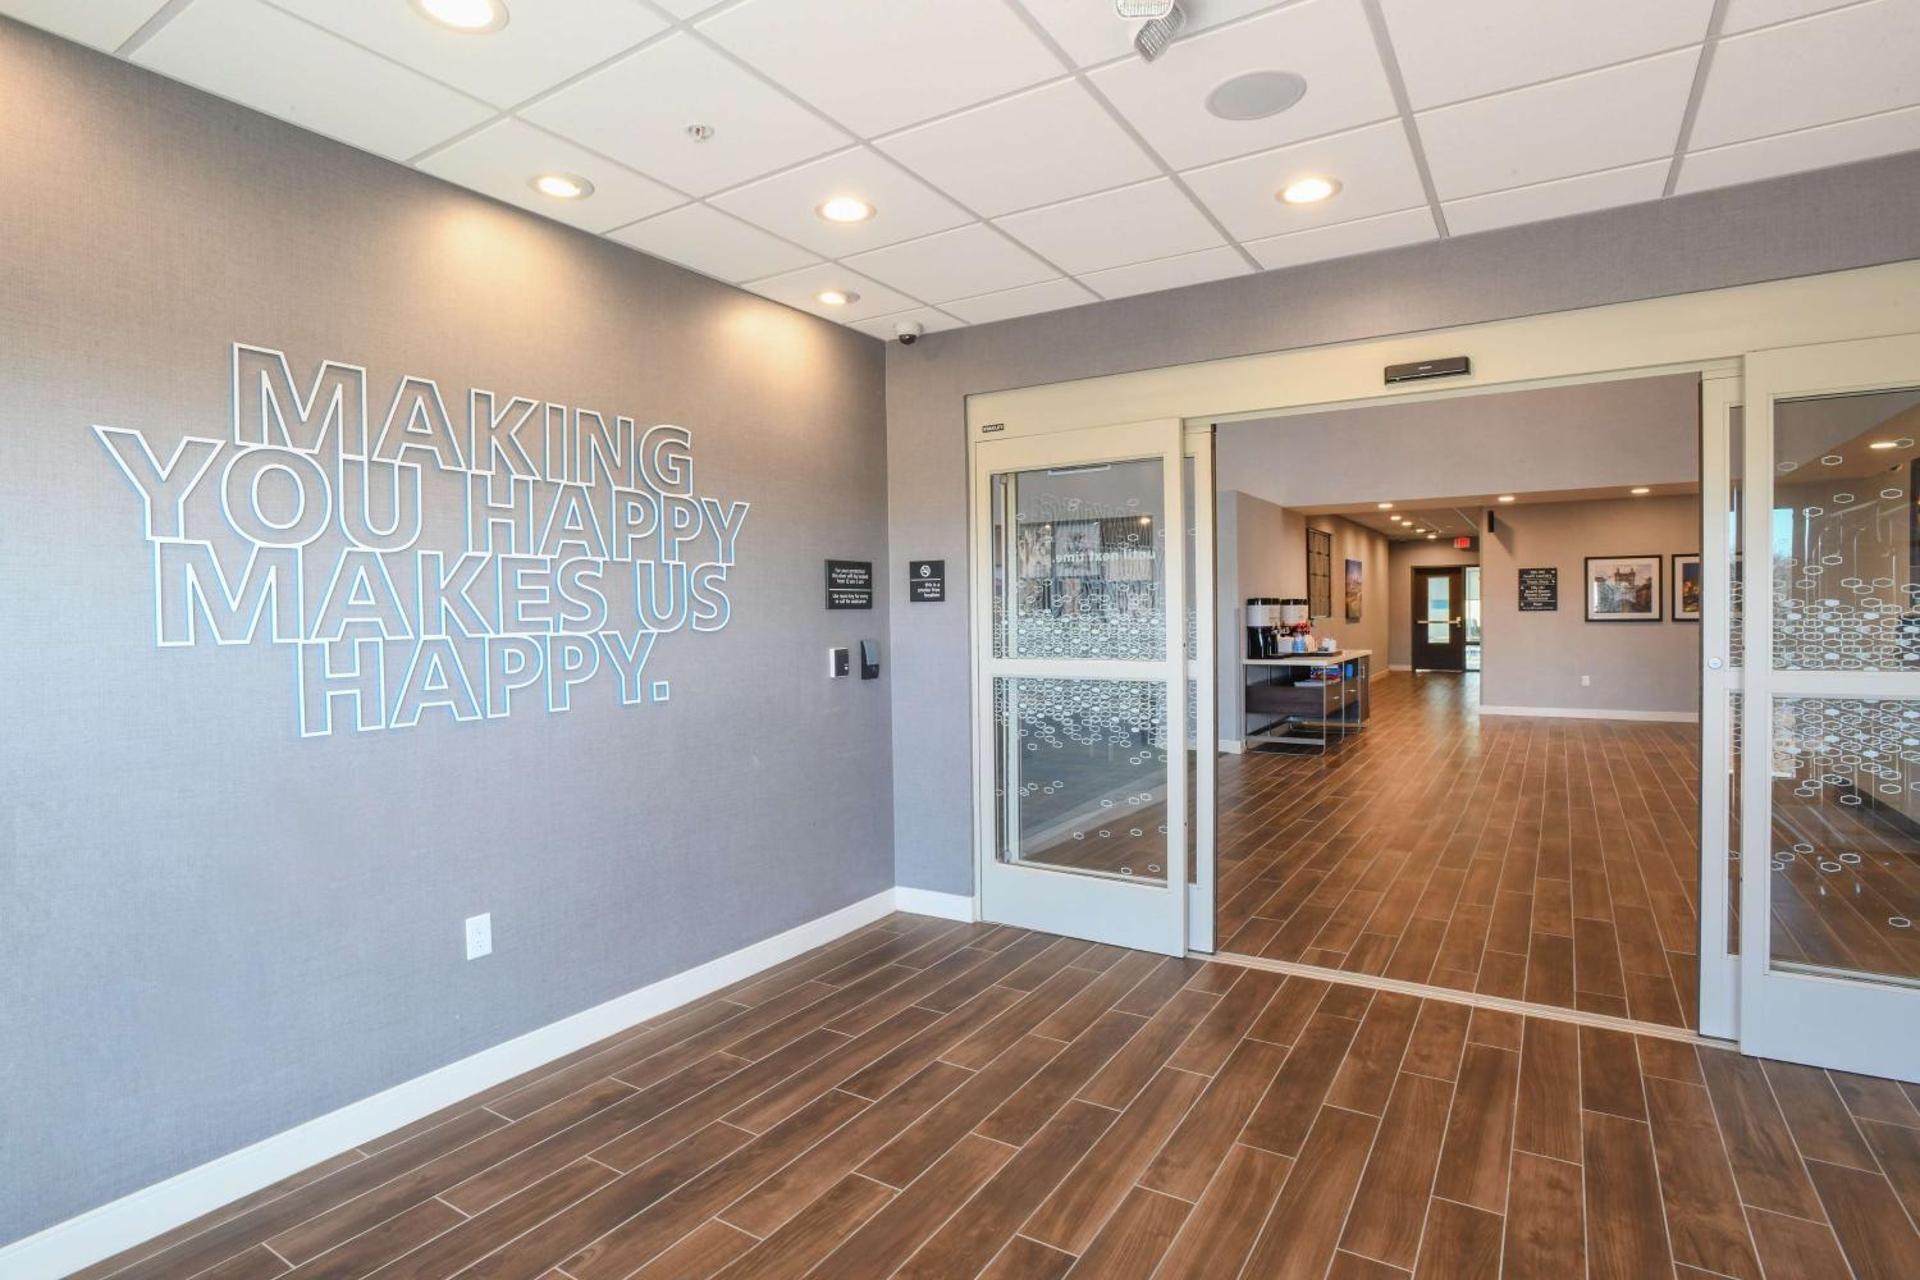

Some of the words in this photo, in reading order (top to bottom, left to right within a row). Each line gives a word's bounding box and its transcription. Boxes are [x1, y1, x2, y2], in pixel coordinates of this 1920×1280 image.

[232, 342, 693, 497] MAKING
[93, 424, 422, 552] YOU
[467, 470, 750, 566] HAPPY
[155, 537, 608, 647] MAKES
[635, 559, 731, 633] US
[300, 630, 669, 737] HAPPY.
